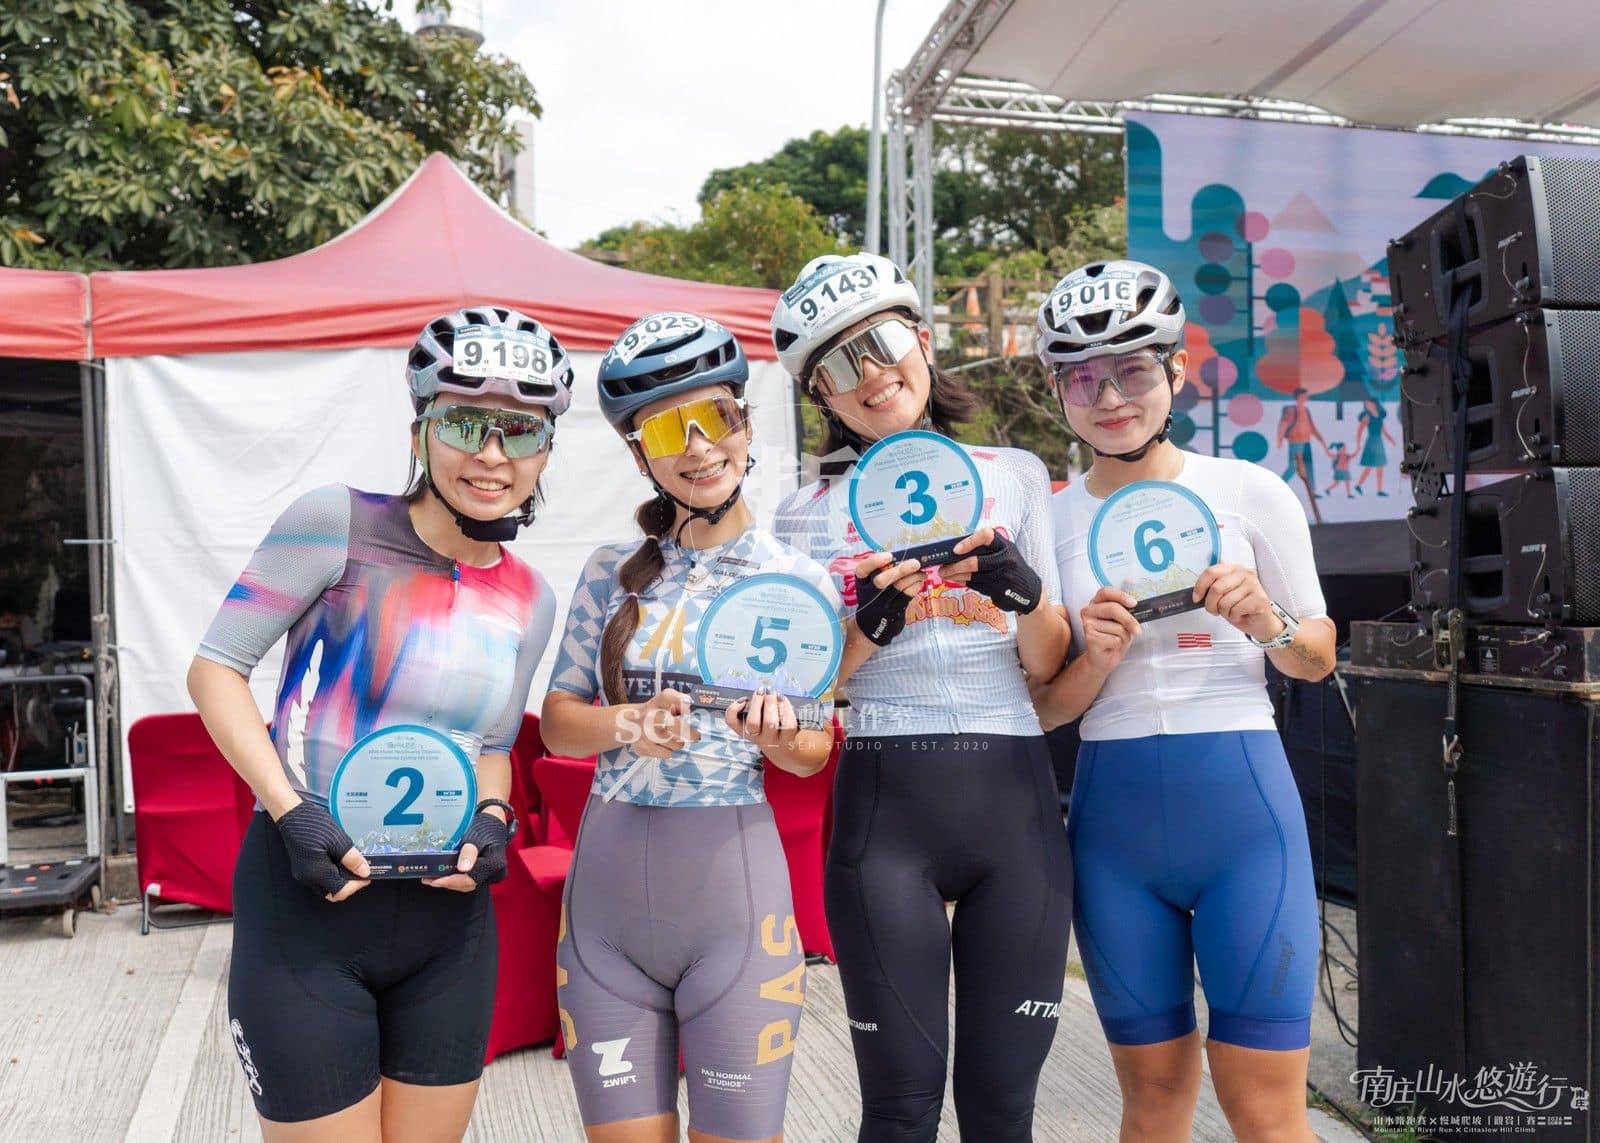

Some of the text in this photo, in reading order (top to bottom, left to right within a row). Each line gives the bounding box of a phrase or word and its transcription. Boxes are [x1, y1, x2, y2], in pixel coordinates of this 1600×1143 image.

[894, 470, 938, 526] 3
[1133, 519, 1175, 573] 6
[746, 615, 791, 674] 5
[383, 766, 425, 826] 2
[602, 1075, 637, 1088] ZWIFT
[701, 1068, 752, 1080] PAS NORMAL
